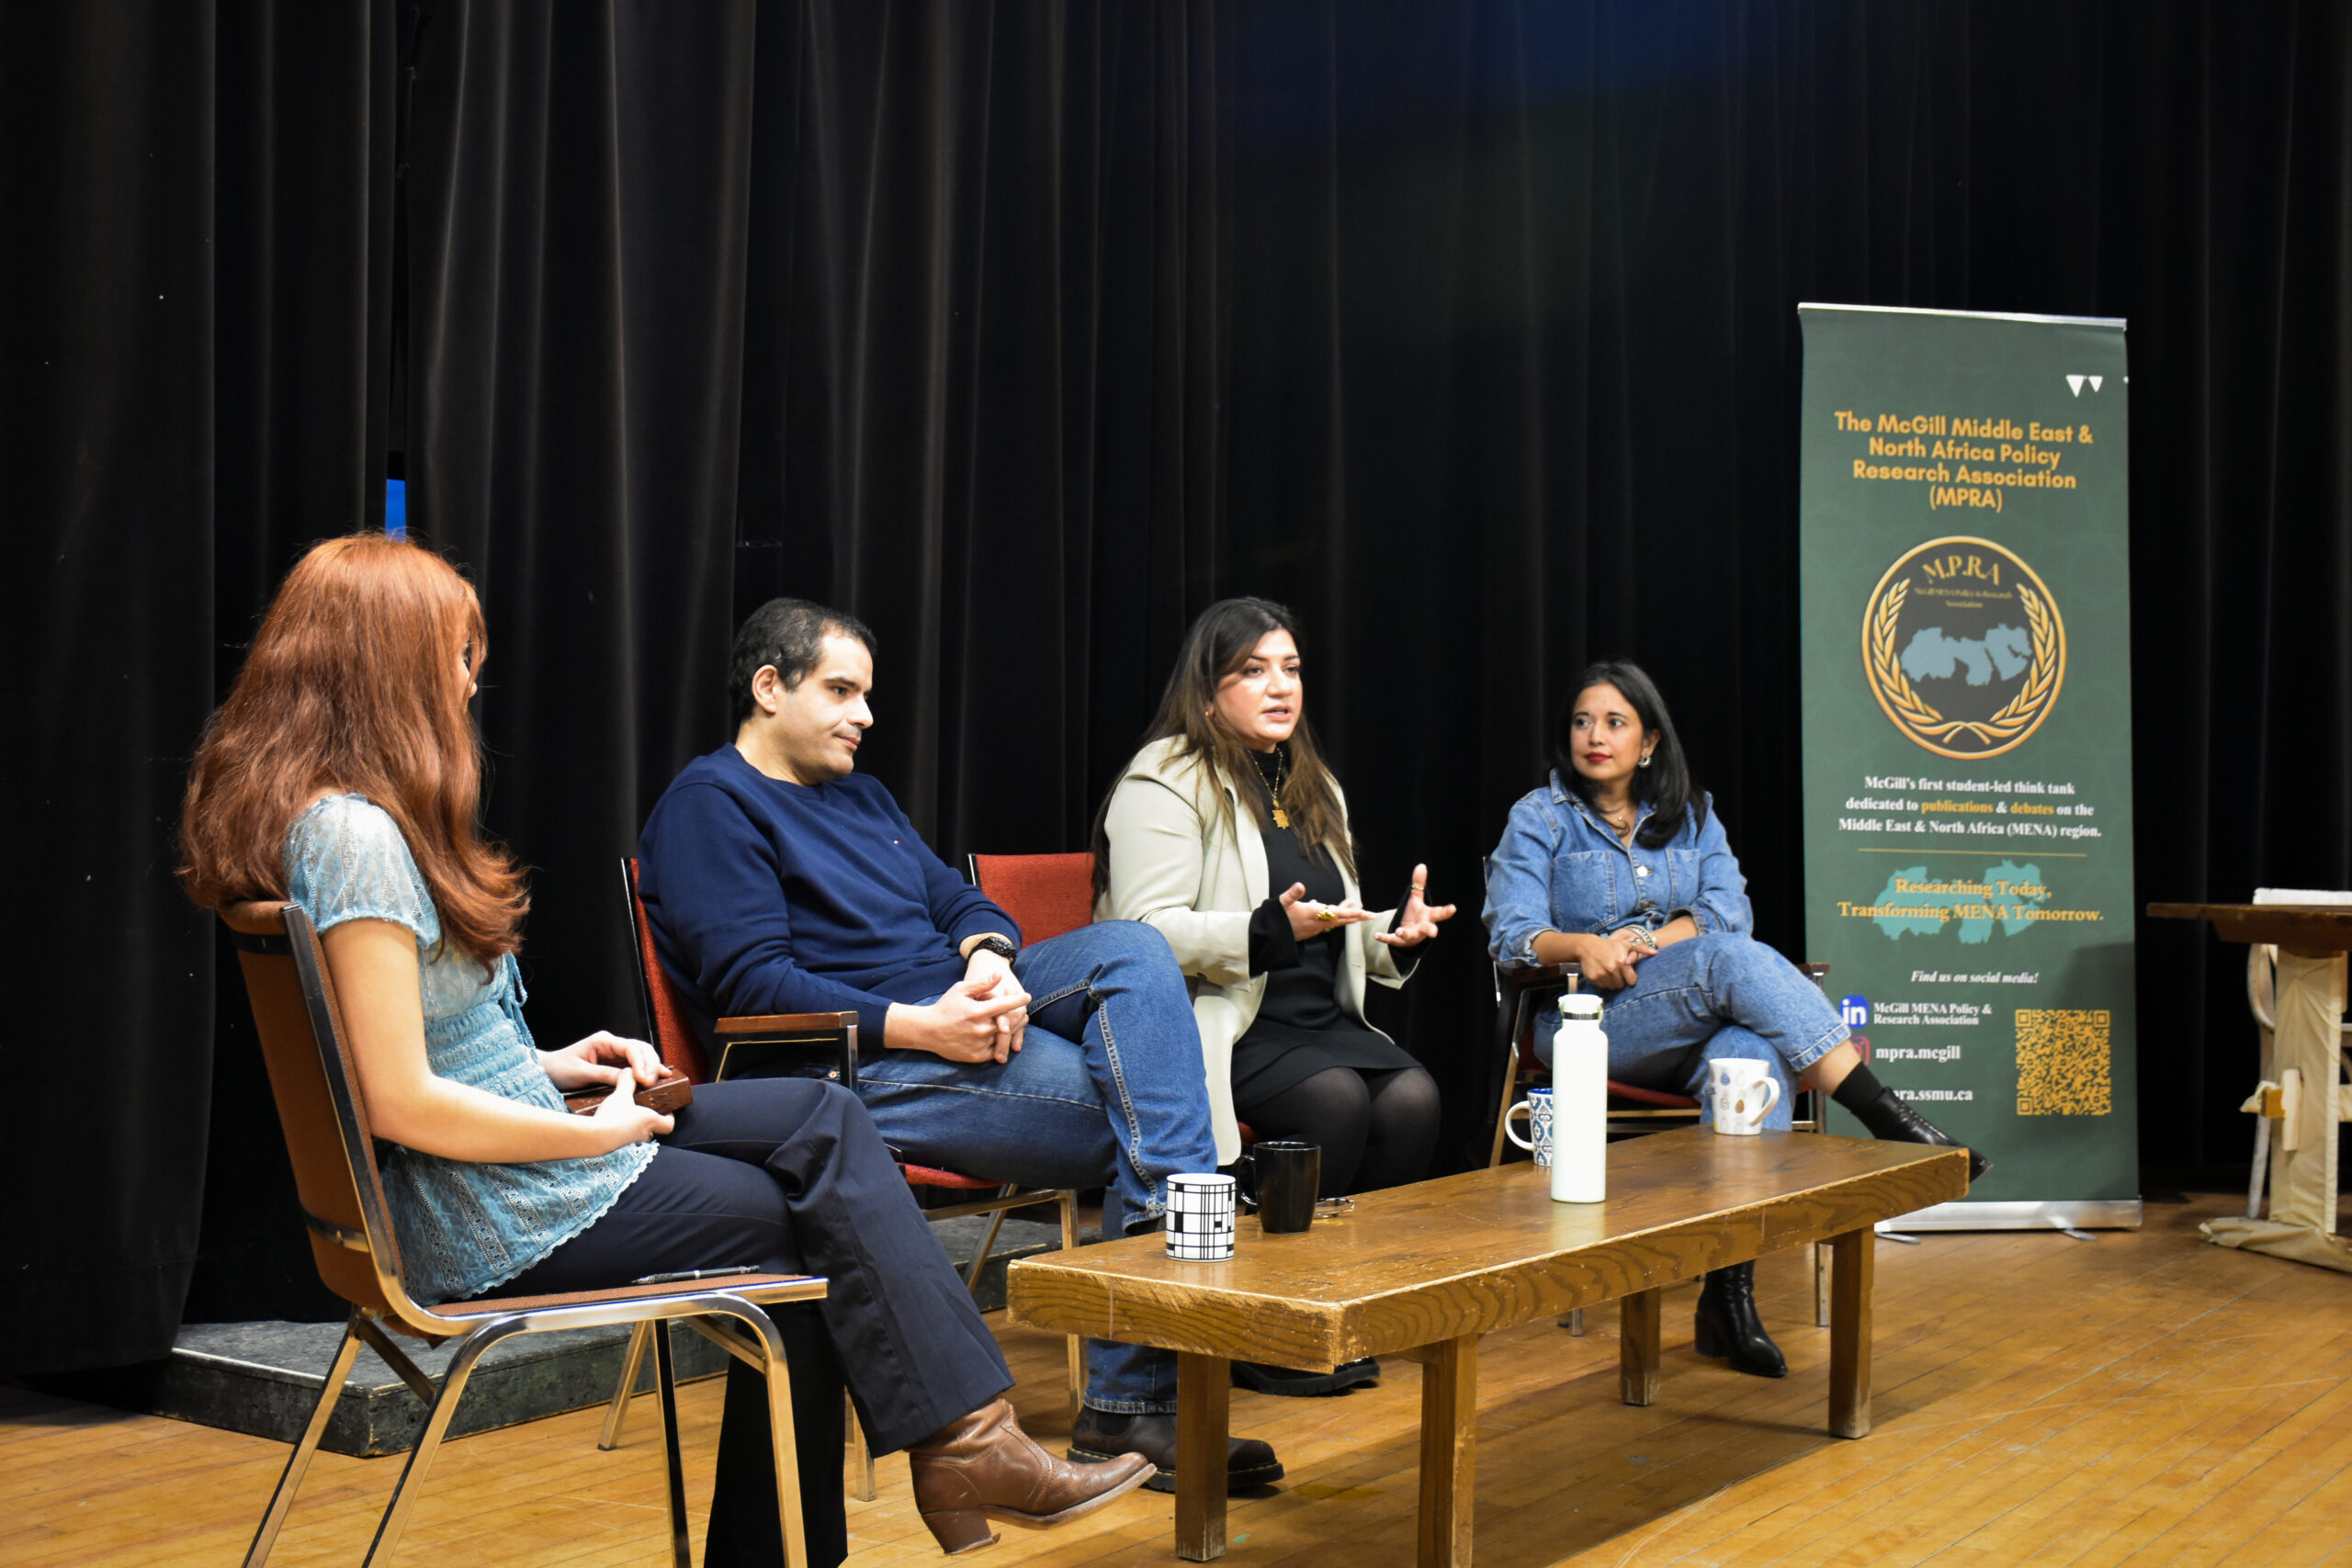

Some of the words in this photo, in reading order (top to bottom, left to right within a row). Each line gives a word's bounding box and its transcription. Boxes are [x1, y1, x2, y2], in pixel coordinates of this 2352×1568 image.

[1835, 411, 1871, 432] The
[1878, 414, 1946, 435] McGill
[1951, 419, 2023, 440] Middle
[2030, 423, 2073, 442] East
[2078, 425, 2093, 443] &
[1870, 437, 1926, 457] North
[1931, 439, 1995, 461] Africa
[2001, 444, 2061, 470] Policy
[1854, 459, 1950, 482] Research
[1956, 466, 2076, 489] Association
[1930, 485, 2002, 513] (MPRA)
[1918, 778, 1943, 790] first
[1946, 780, 2011, 793] student-led
[2014, 782, 2045, 794] think
[2048, 783, 2075, 795] tank
[1846, 797, 1904, 810] dedicated
[1906, 801, 1918, 810] to
[1921, 800, 1994, 814] publications
[1996, 801, 2007, 813] &
[2010, 802, 2054, 815] debates
[2056, 807, 2072, 815] on
[2075, 804, 2094, 816] the
[1839, 818, 1883, 831] Middle
[1886, 819, 1911, 831] East
[1915, 820, 1926, 832] &
[1929, 821, 1964, 833] North
[1967, 822, 2004, 834] Africa
[2007, 823, 2057, 838] (MENA)
[2061, 825, 2101, 839] region.
[1895, 878, 1994, 898] Researching
[1996, 880, 2052, 897] Today,
[1838, 902, 1950, 922] Transforming
[1954, 904, 2008, 919] MENA
[2011, 905, 2103, 920] Tomorrow.
[1911, 971, 1938, 982] Find
[1970, 972, 2001, 983] social
[2002, 973, 2039, 983] media!
[1874, 1003, 1909, 1013] McGill
[1912, 1003, 1947, 1013] MENA
[1950, 1003, 1979, 1016] Policy
[1982, 1004, 1992, 1014] &
[1874, 1014, 1920, 1024] Research
[1922, 1014, 1979, 1025] Association
[1876, 1045, 1961, 1063] mpra.mcgill
